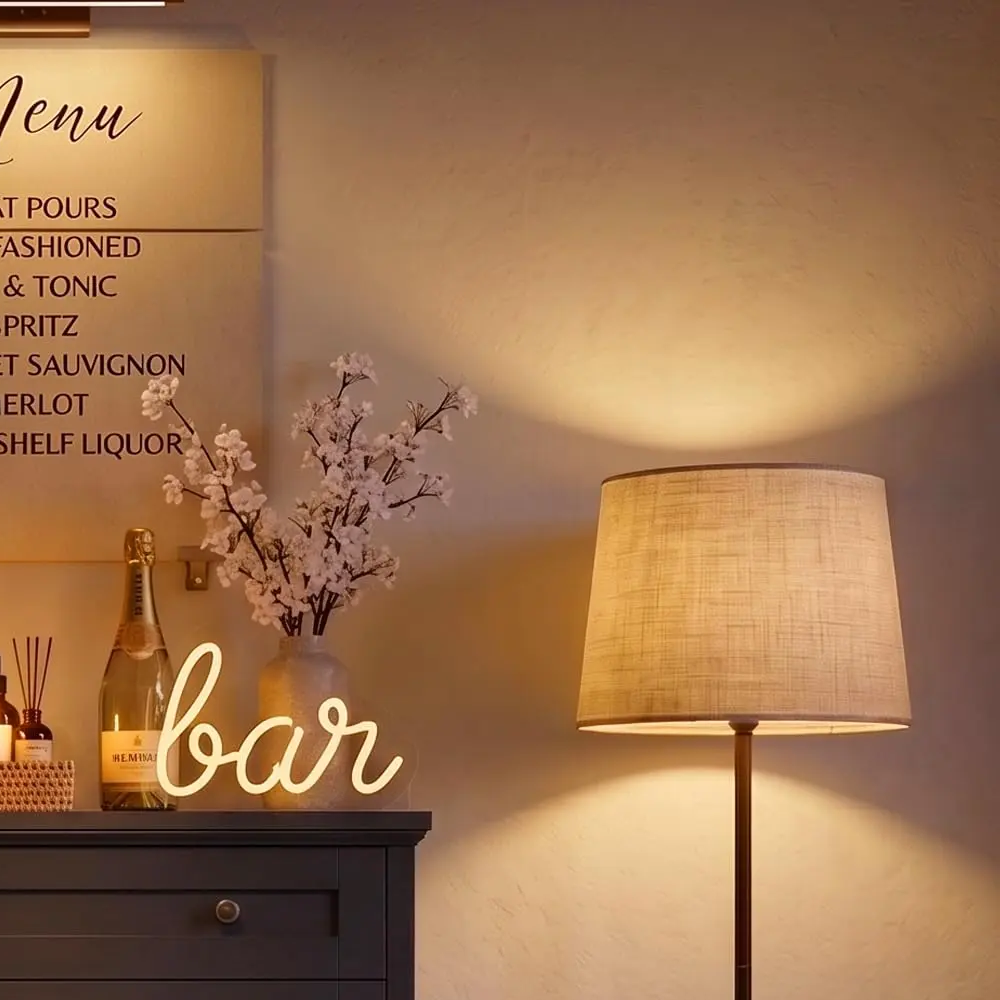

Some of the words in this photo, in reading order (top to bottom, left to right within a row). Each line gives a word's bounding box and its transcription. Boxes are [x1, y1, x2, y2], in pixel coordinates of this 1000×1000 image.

[27, 196, 118, 220] POURS
[2, 274, 26, 298] &
[32, 274, 118, 298] TONIC
[27, 353, 186, 377] SAUVIGNON
[81, 432, 184, 459] LIQUOR
[155, 642, 404, 798] bar
